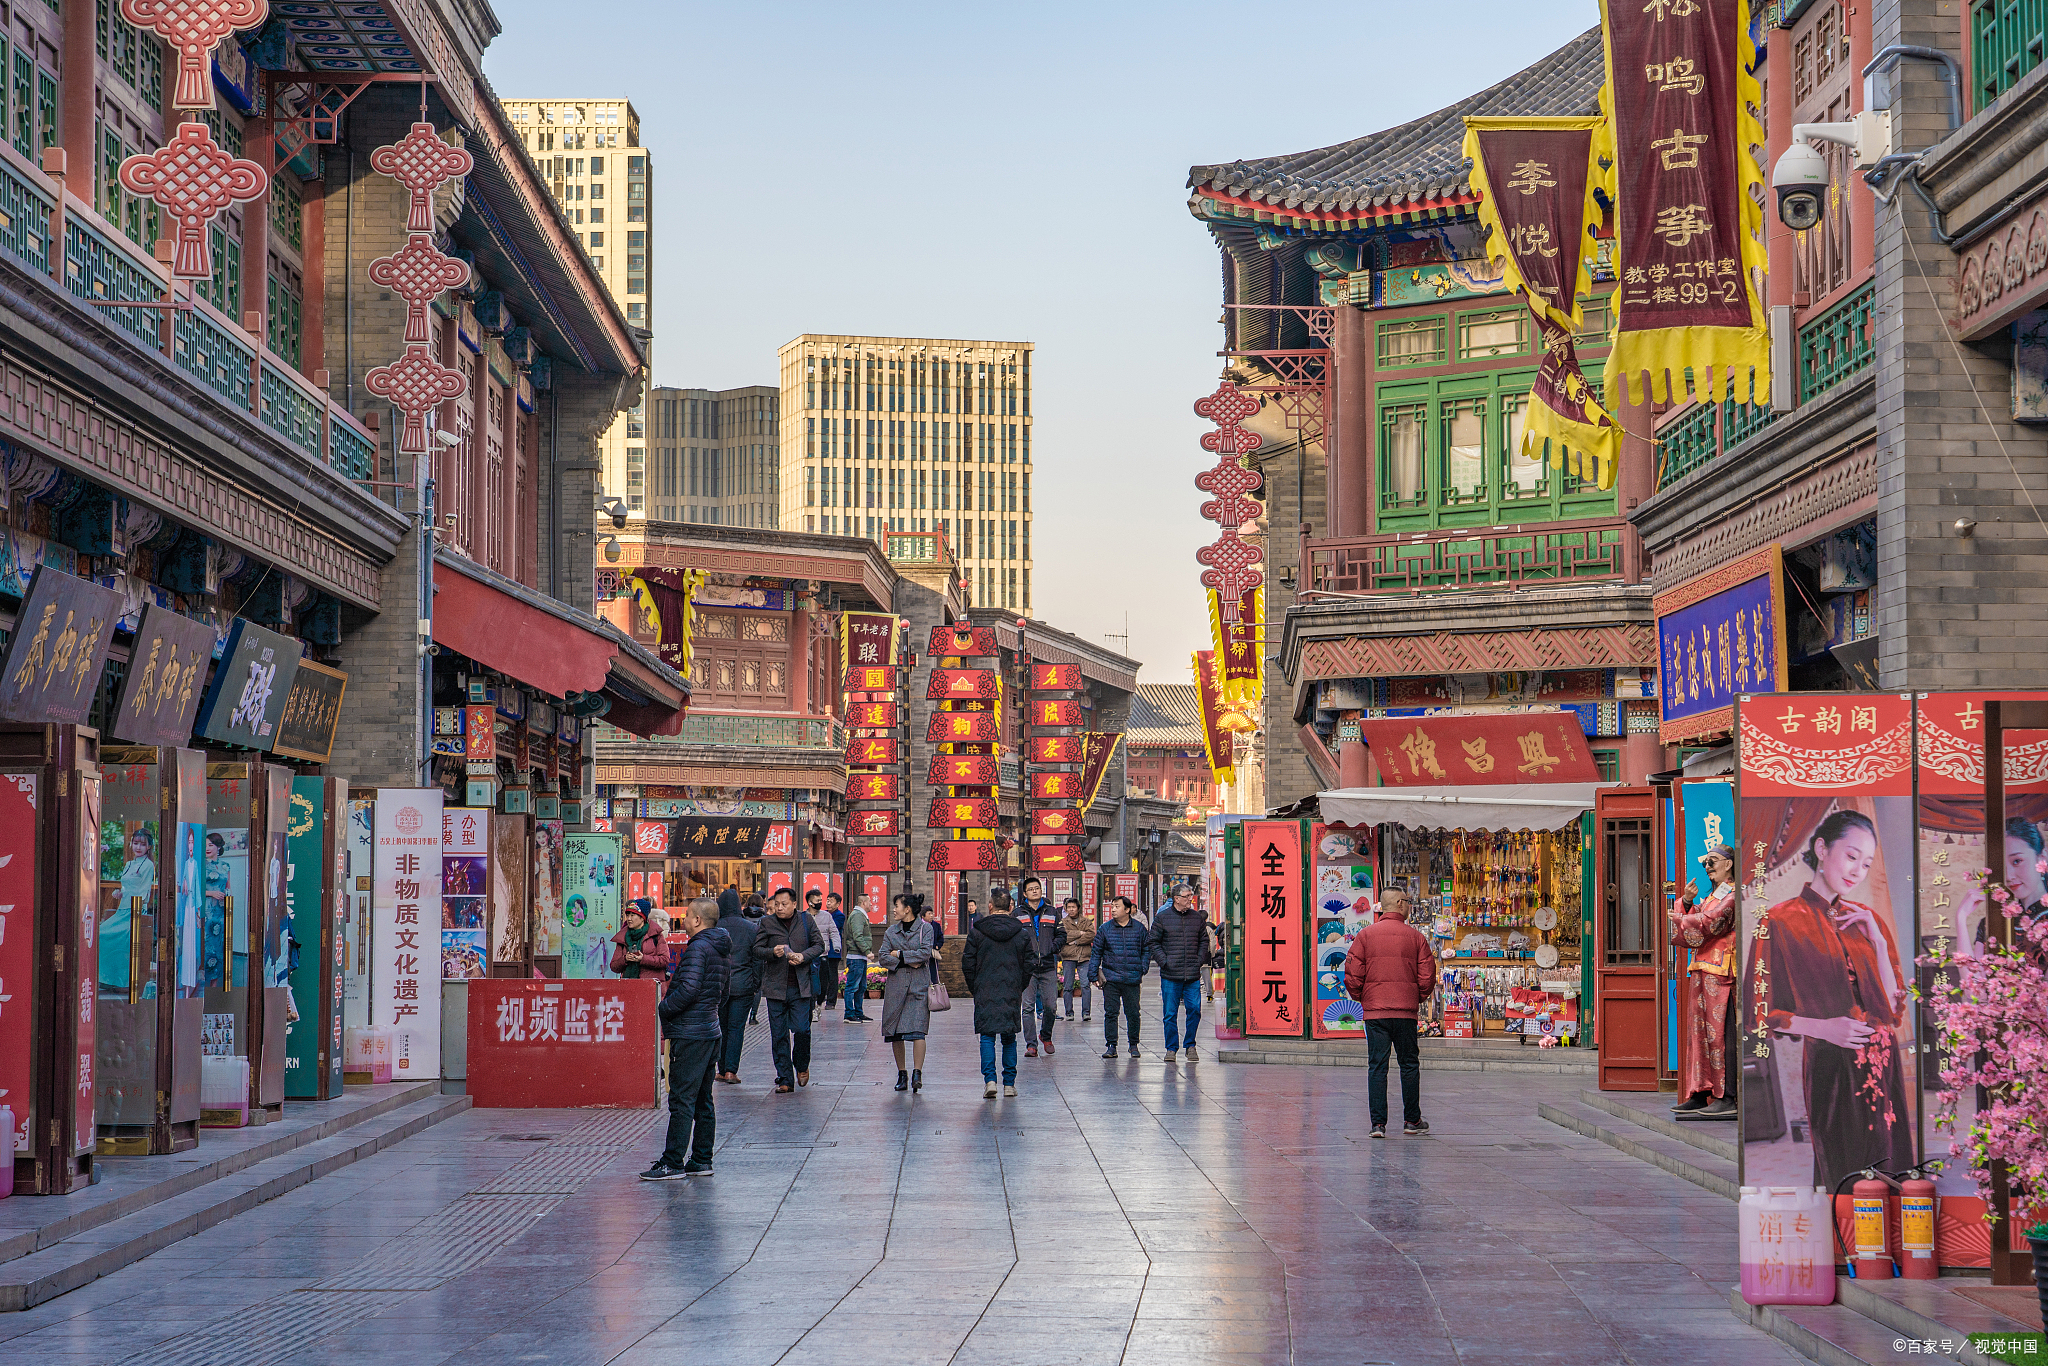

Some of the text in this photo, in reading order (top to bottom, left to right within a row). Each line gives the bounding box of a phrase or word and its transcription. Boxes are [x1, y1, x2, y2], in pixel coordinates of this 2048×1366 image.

[1624, 258, 1738, 284] 教学工作室
[1624, 281, 1739, 305] 二楼99-2
[851, 623, 889, 637] 百年老店
[1776, 705, 1878, 736] 古韵阁
[123, 796, 154, 804] XIANG
[217, 806, 246, 814] XIANG
[762, 827, 789, 854] 刺
[947, 874, 958, 914] 津门老店
[332, 847, 345, 1050] 中华老字号
[393, 853, 421, 1026] 非物质文化遗产
[1750, 840, 1771, 1060] 穿最美旗袍 来津门古韵
[496, 995, 625, 1042] 视频监控
